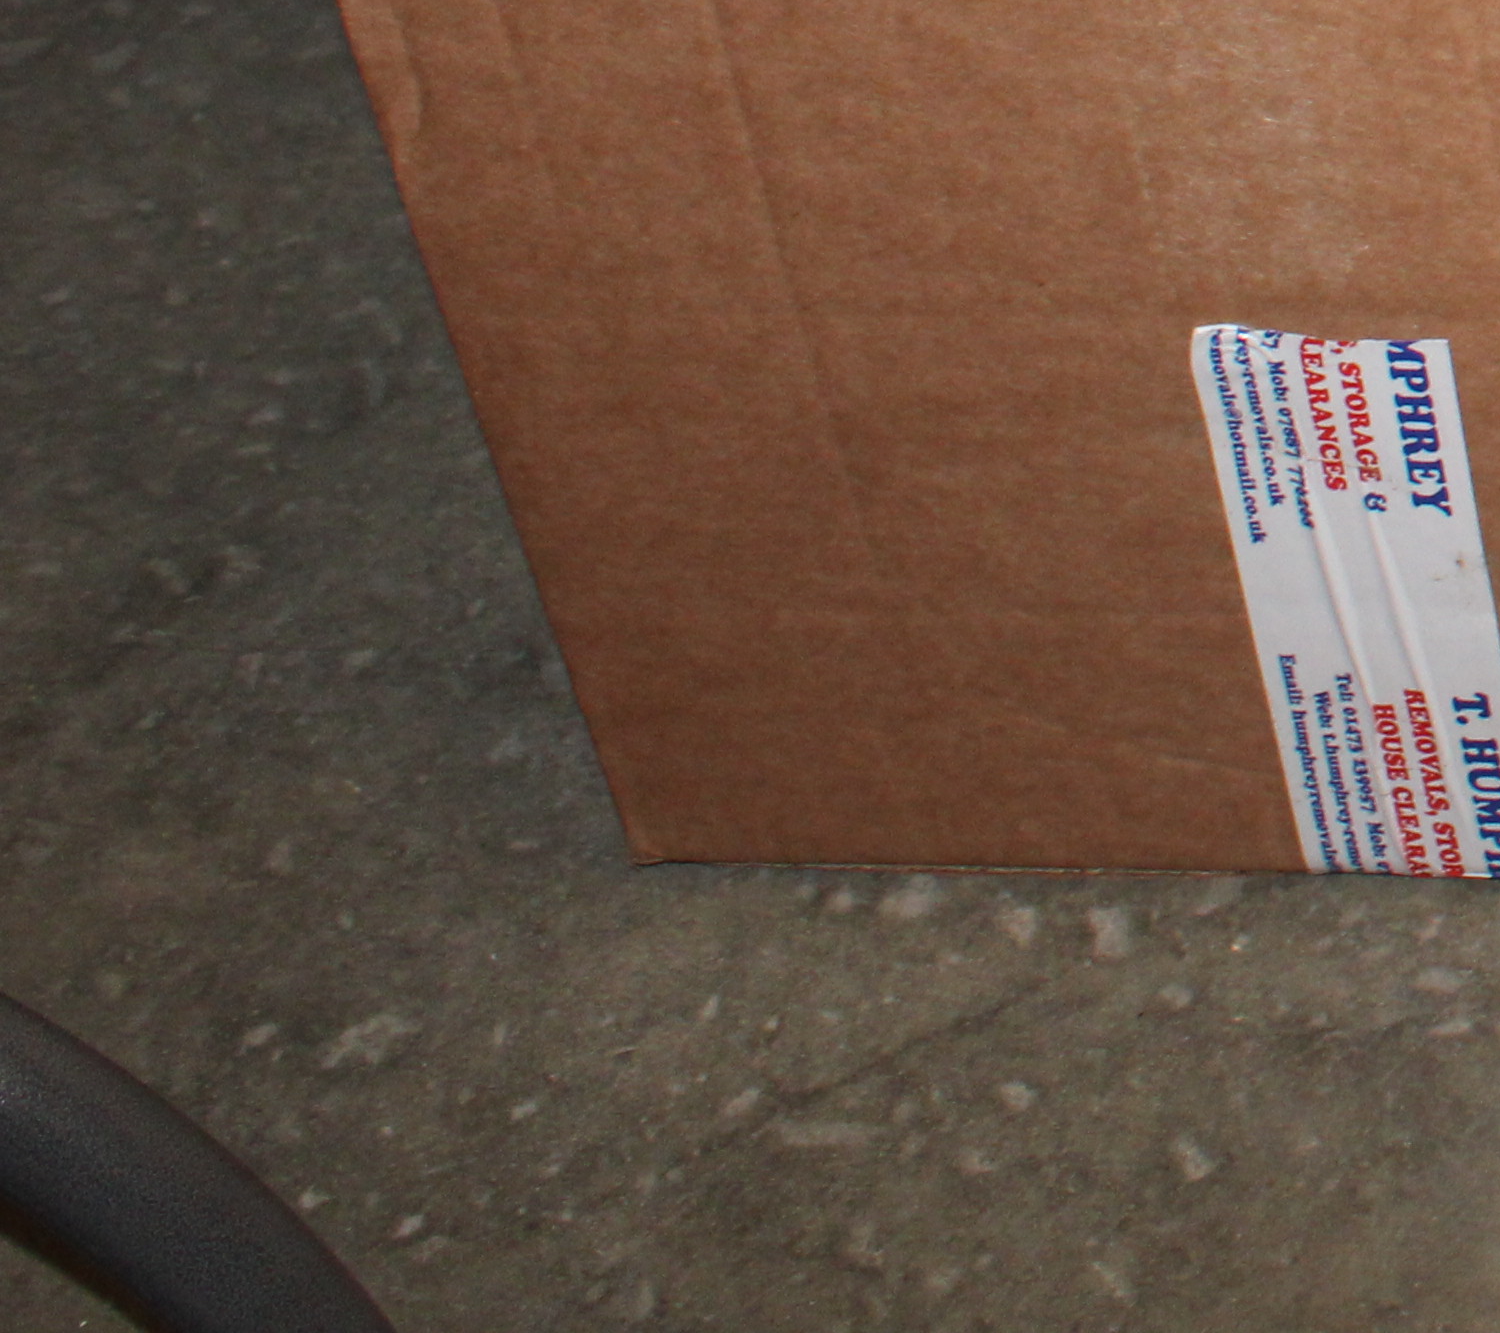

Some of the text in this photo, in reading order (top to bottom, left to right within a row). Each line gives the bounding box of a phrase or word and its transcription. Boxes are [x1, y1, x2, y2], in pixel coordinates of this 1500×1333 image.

[1338, 361, 1382, 483] STORAGE
[1363, 492, 1388, 513] &
[1372, 703, 1410, 781] HOUSE
[1403, 688, 1450, 817] REMOVALS,
[1452, 692, 1491, 725] T.
